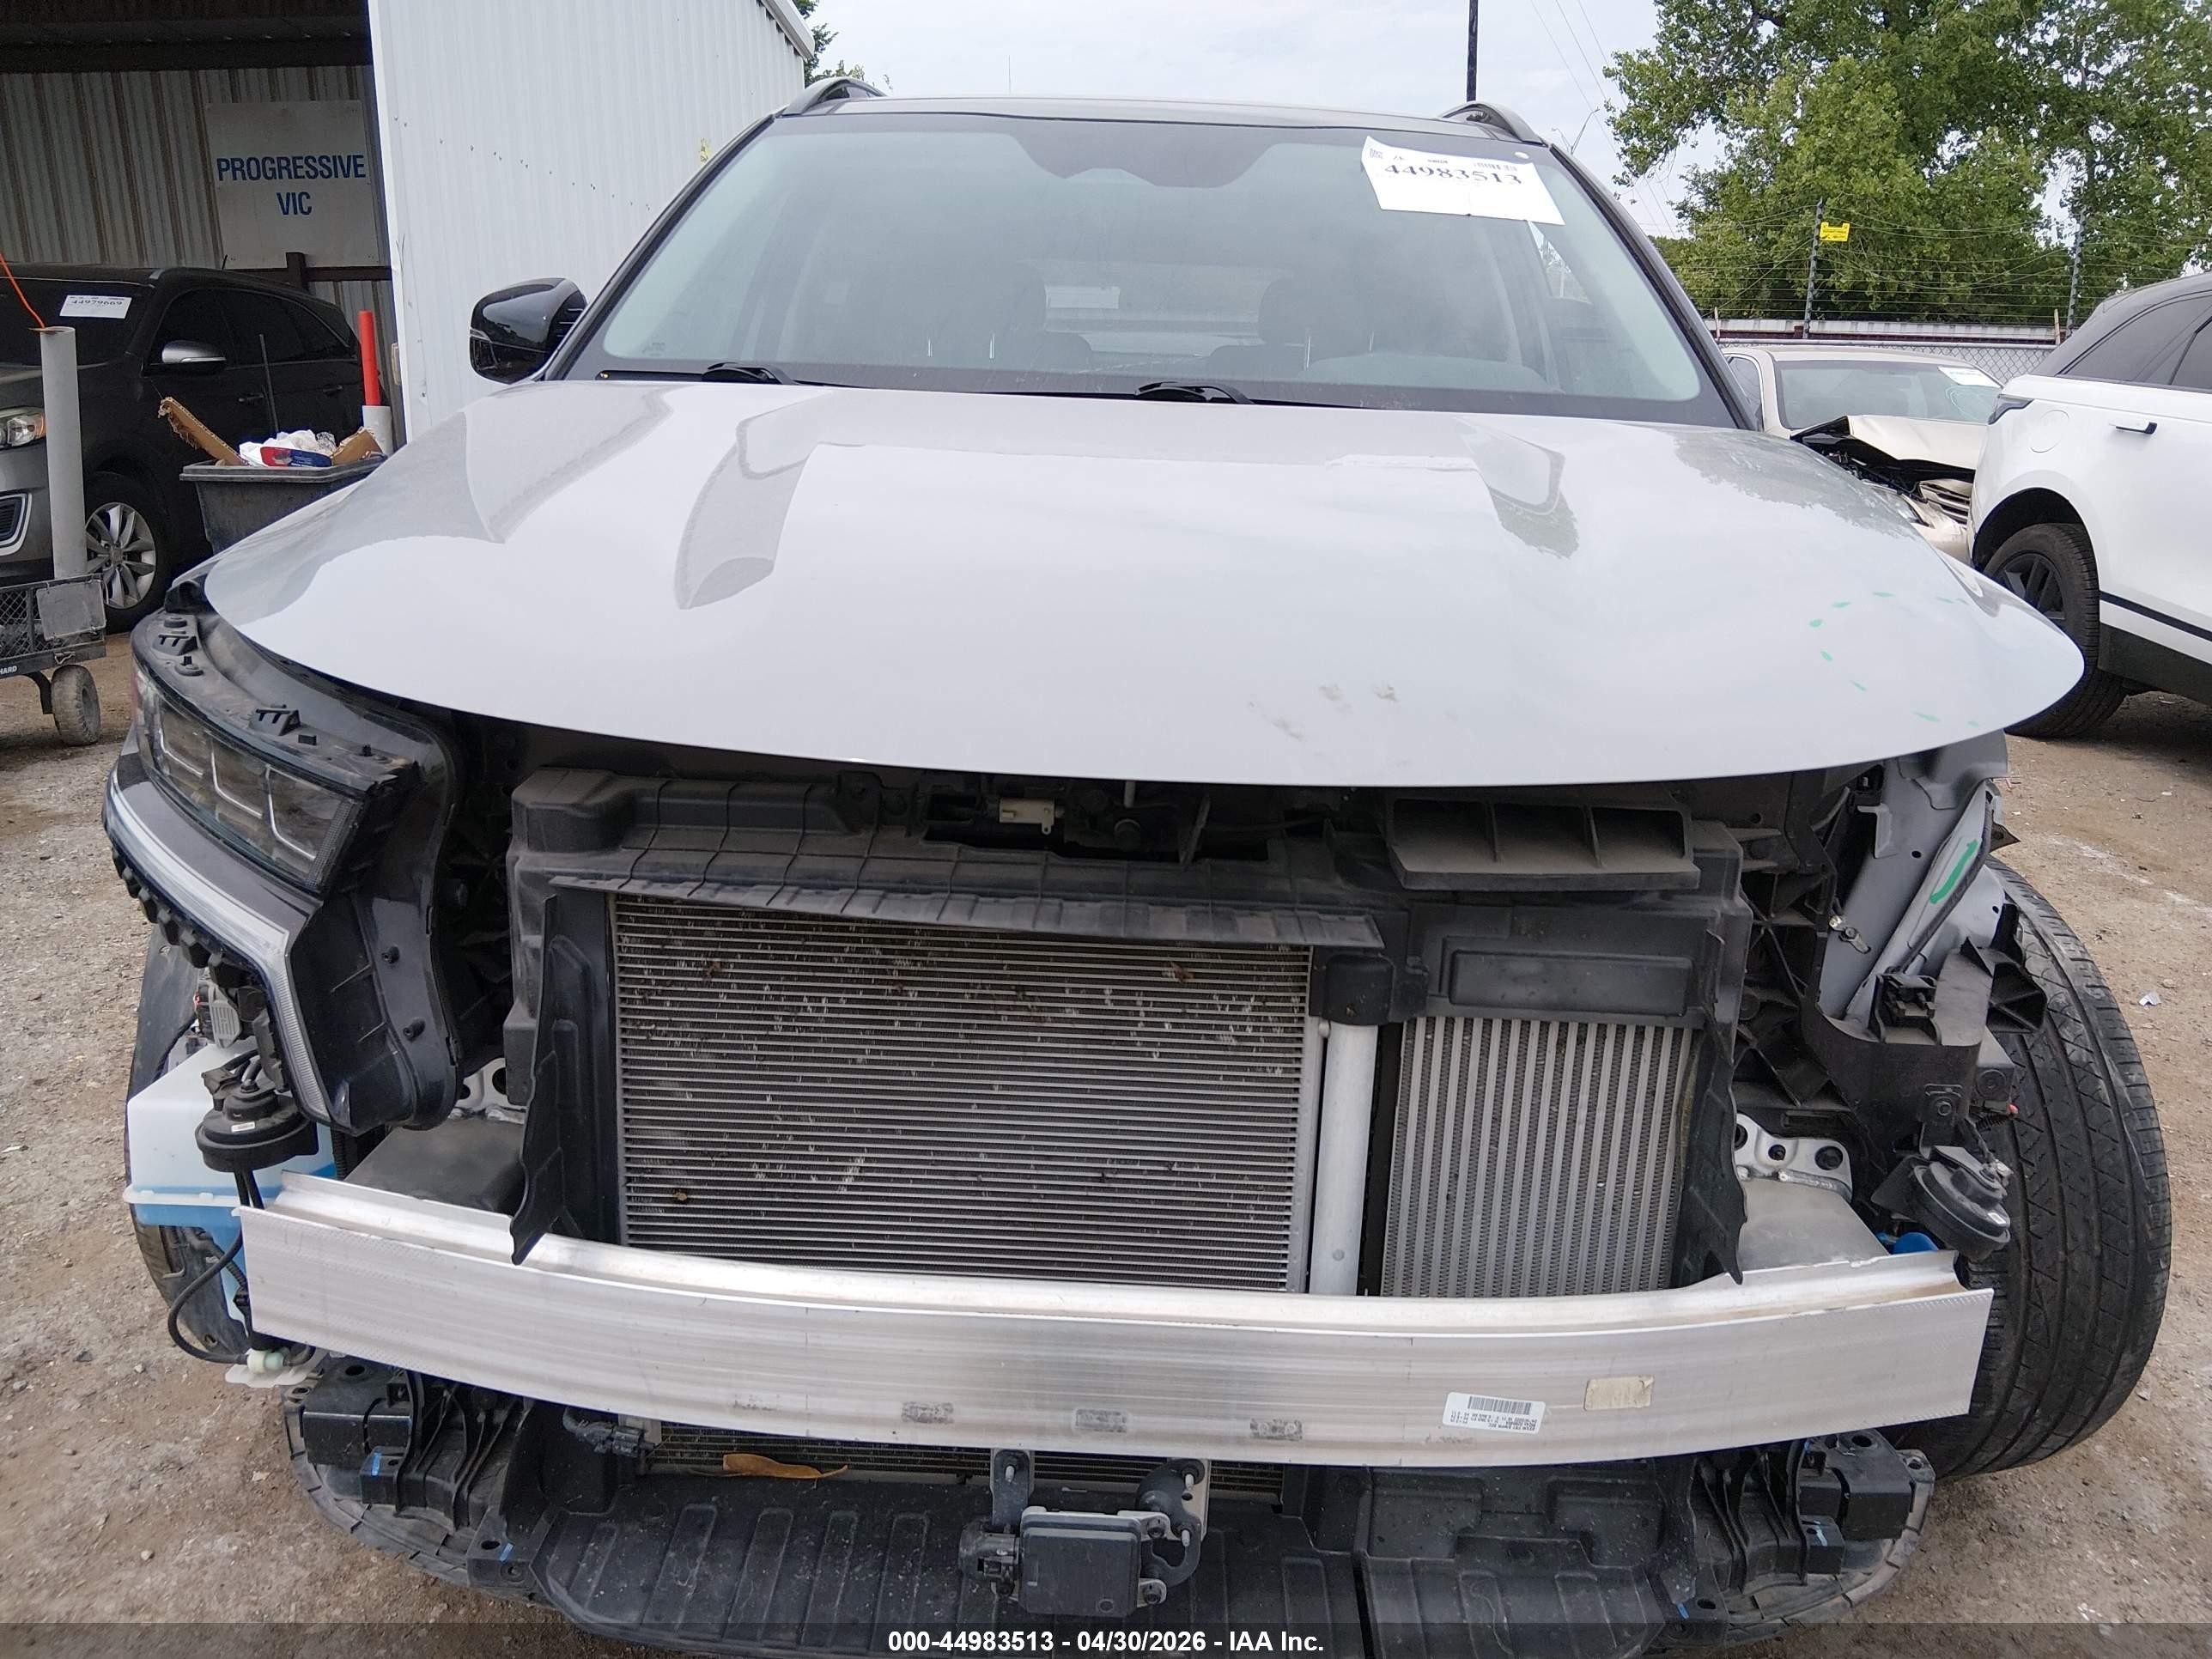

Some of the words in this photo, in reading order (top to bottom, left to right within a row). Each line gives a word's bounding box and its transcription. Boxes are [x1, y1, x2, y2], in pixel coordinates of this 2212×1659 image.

[216, 155, 366, 181] PROGRESSIVE
[1384, 164, 1522, 185] 44983513
[276, 191, 313, 215] VIC
